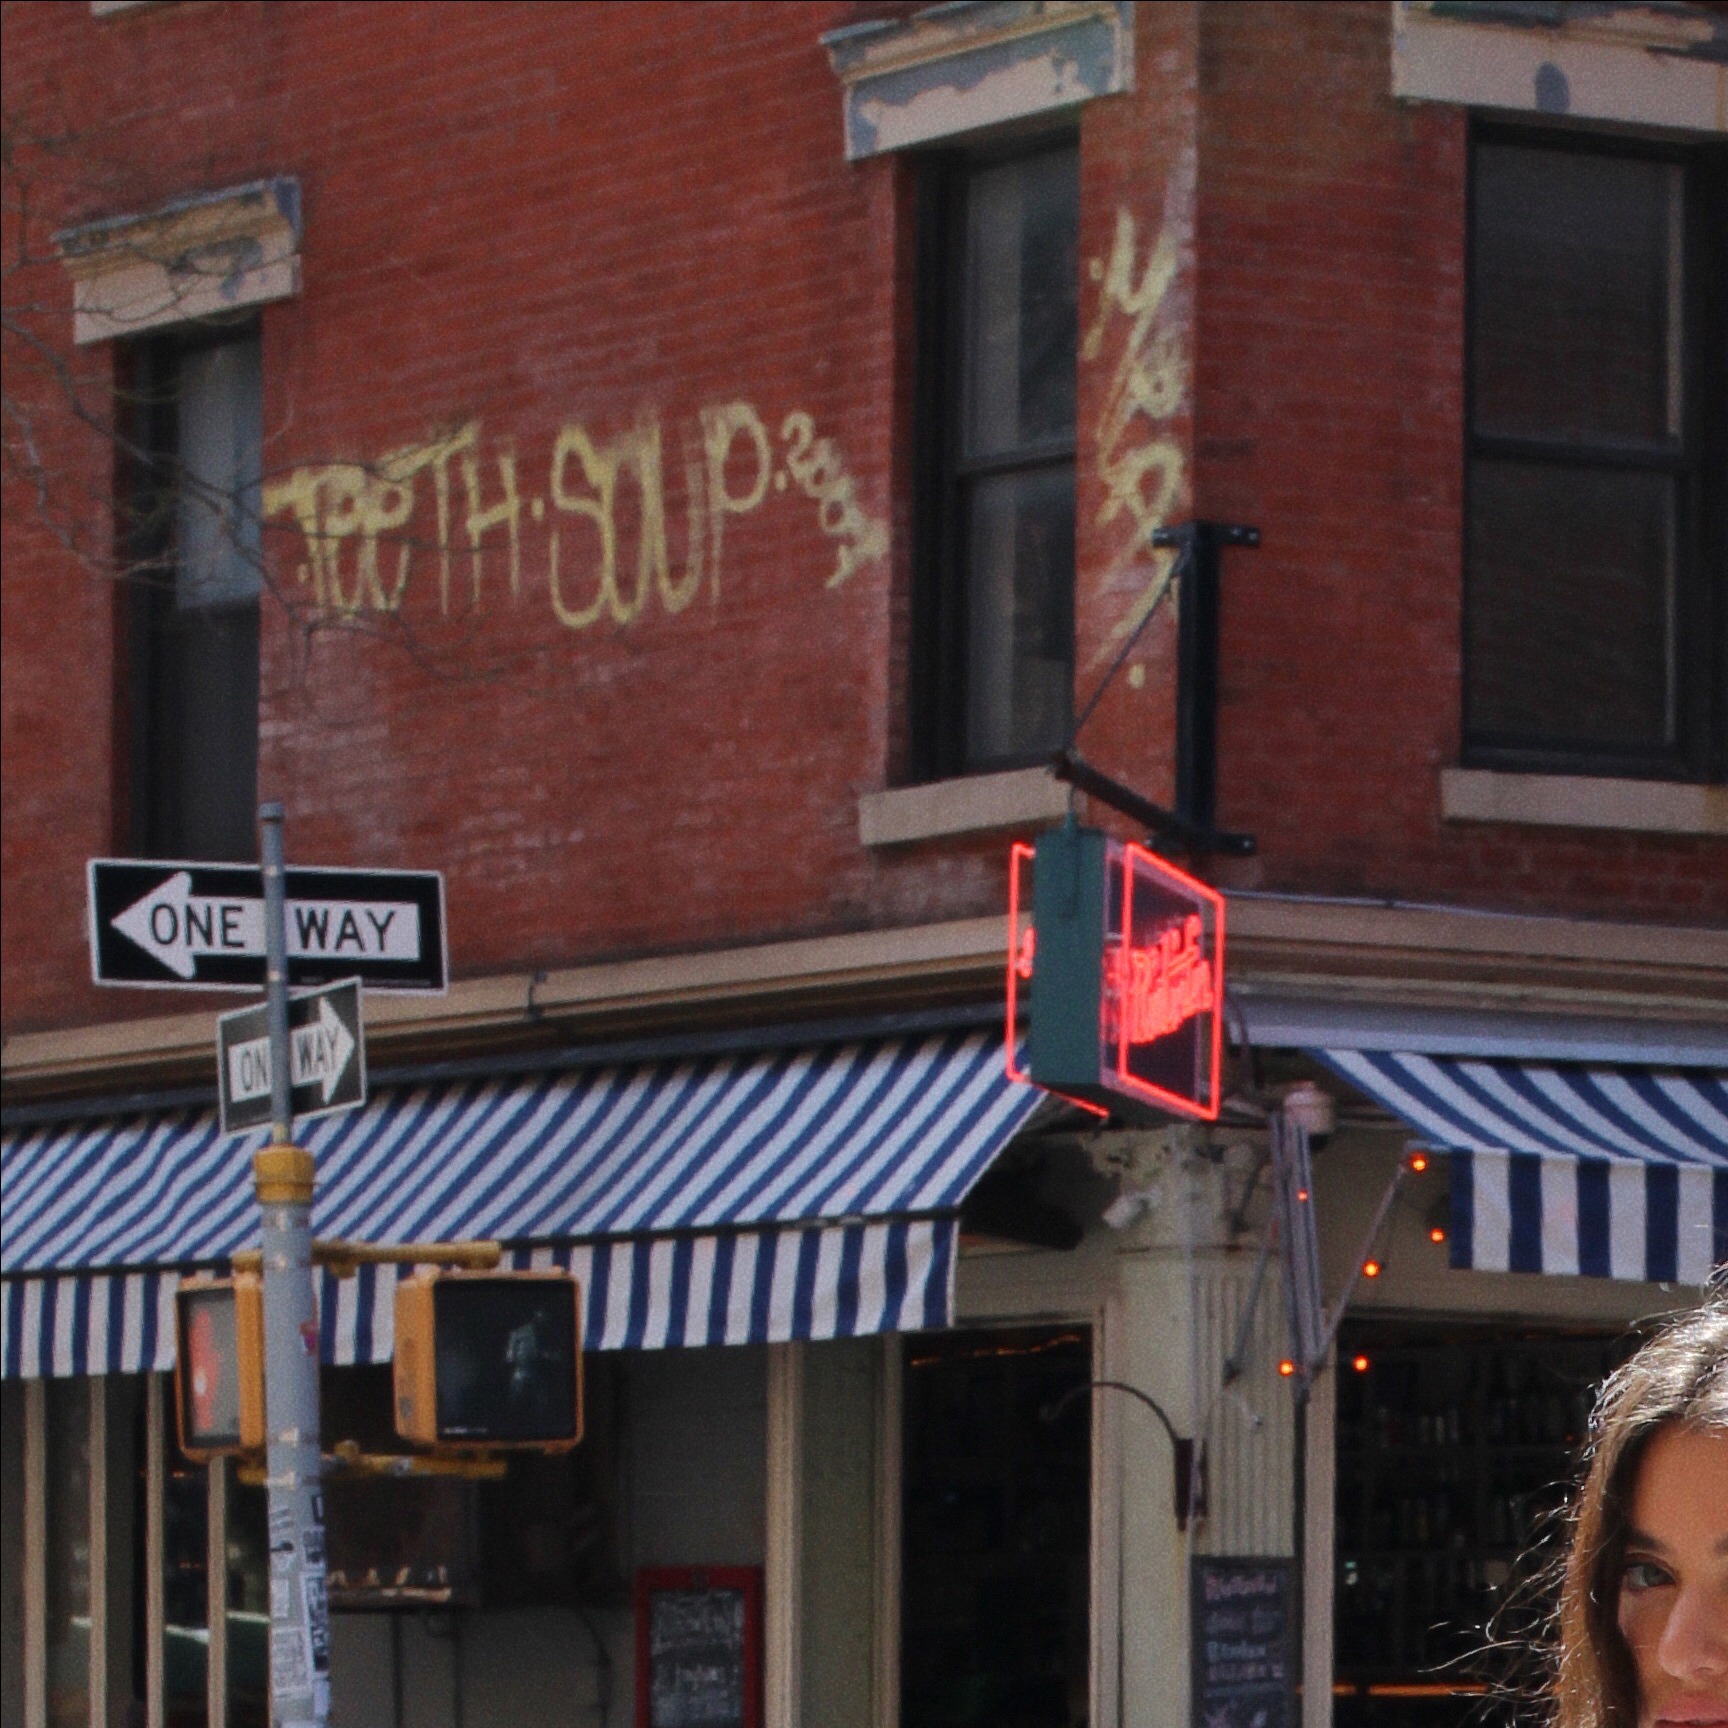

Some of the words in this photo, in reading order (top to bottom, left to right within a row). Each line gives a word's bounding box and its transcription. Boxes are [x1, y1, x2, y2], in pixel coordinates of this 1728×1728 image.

[149, 904, 245, 949] ONE
[295, 909, 396, 954] WAY
[240, 1042, 271, 1092] ON
[296, 1024, 340, 1076] WAY
